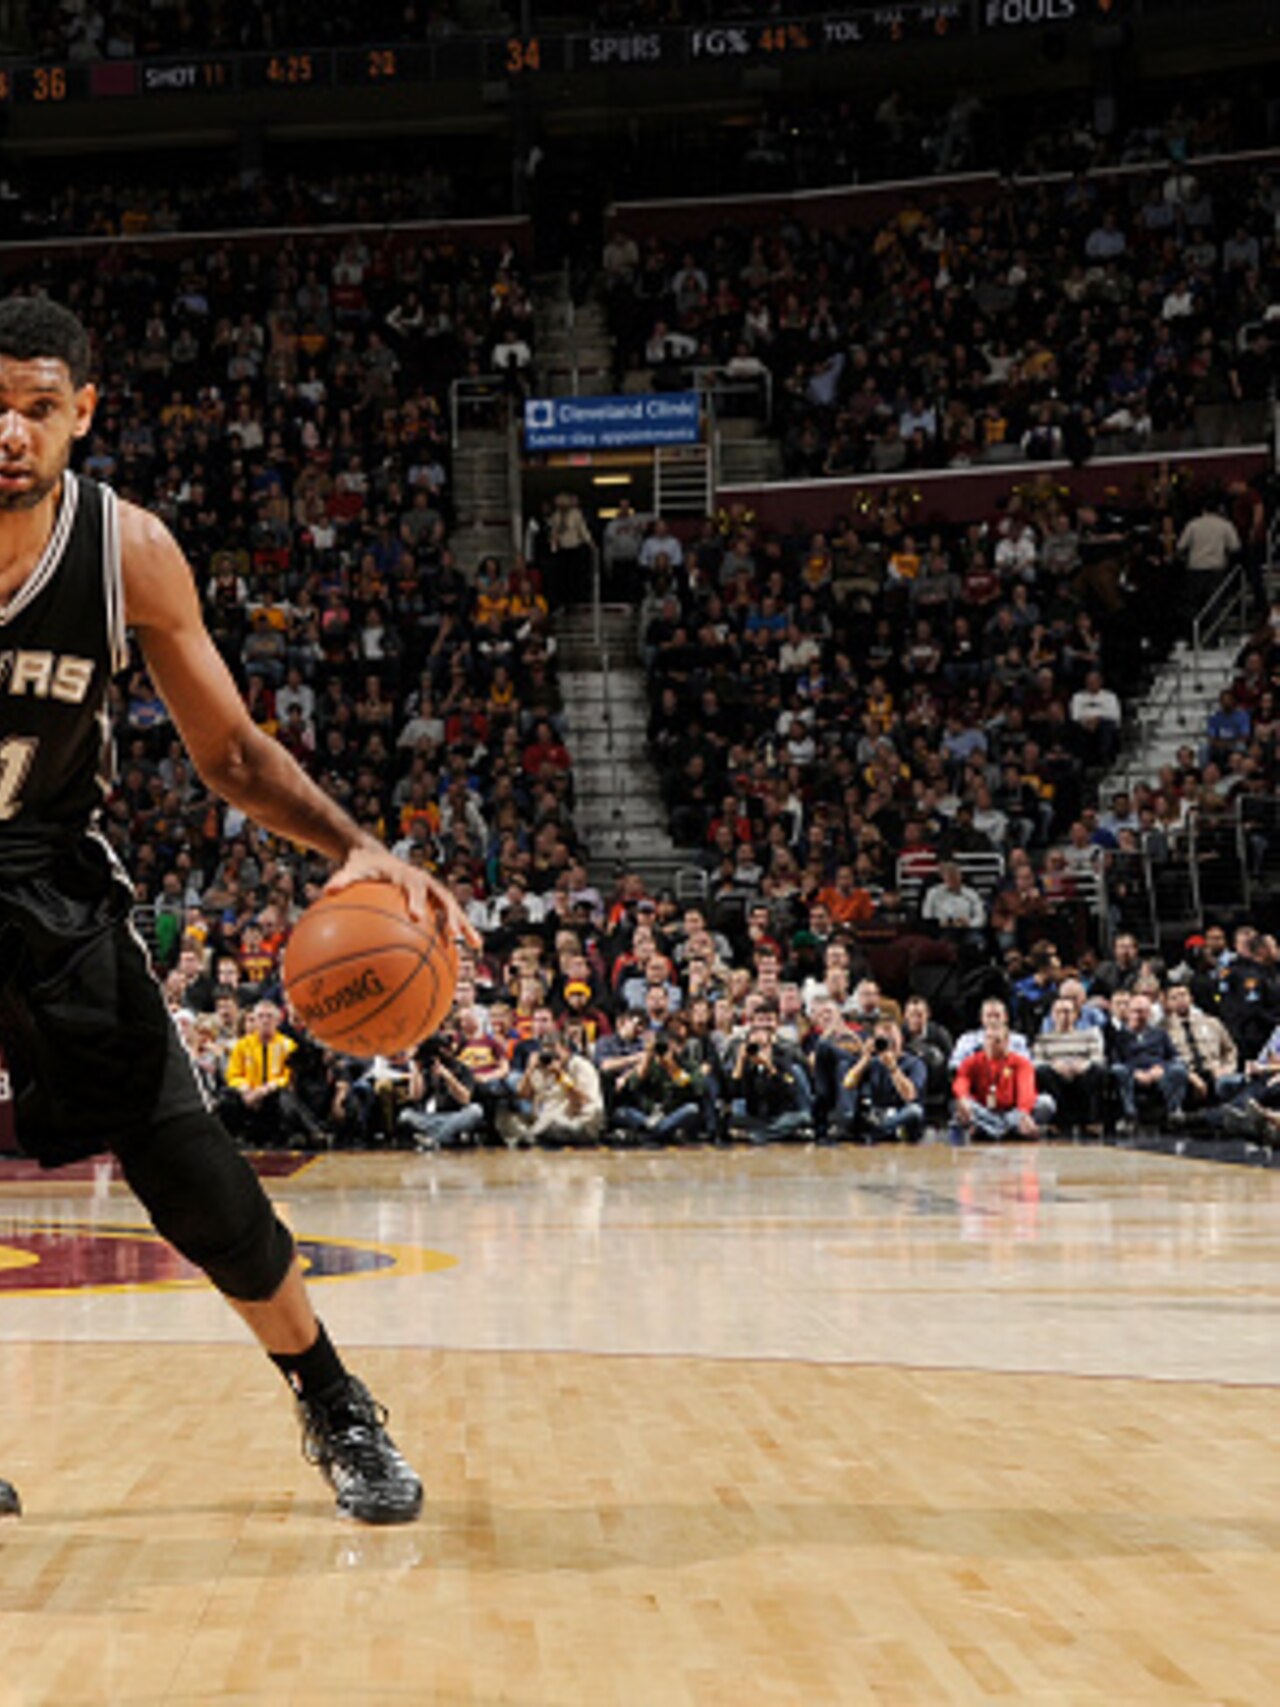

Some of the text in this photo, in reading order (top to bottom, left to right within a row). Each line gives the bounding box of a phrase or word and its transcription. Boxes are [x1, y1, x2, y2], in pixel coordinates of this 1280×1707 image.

[691, 28, 750, 57] FG%
[33, 68, 66, 100] 36
[144, 65, 199, 88] SHOT
[559, 403, 643, 424] Cleveland
